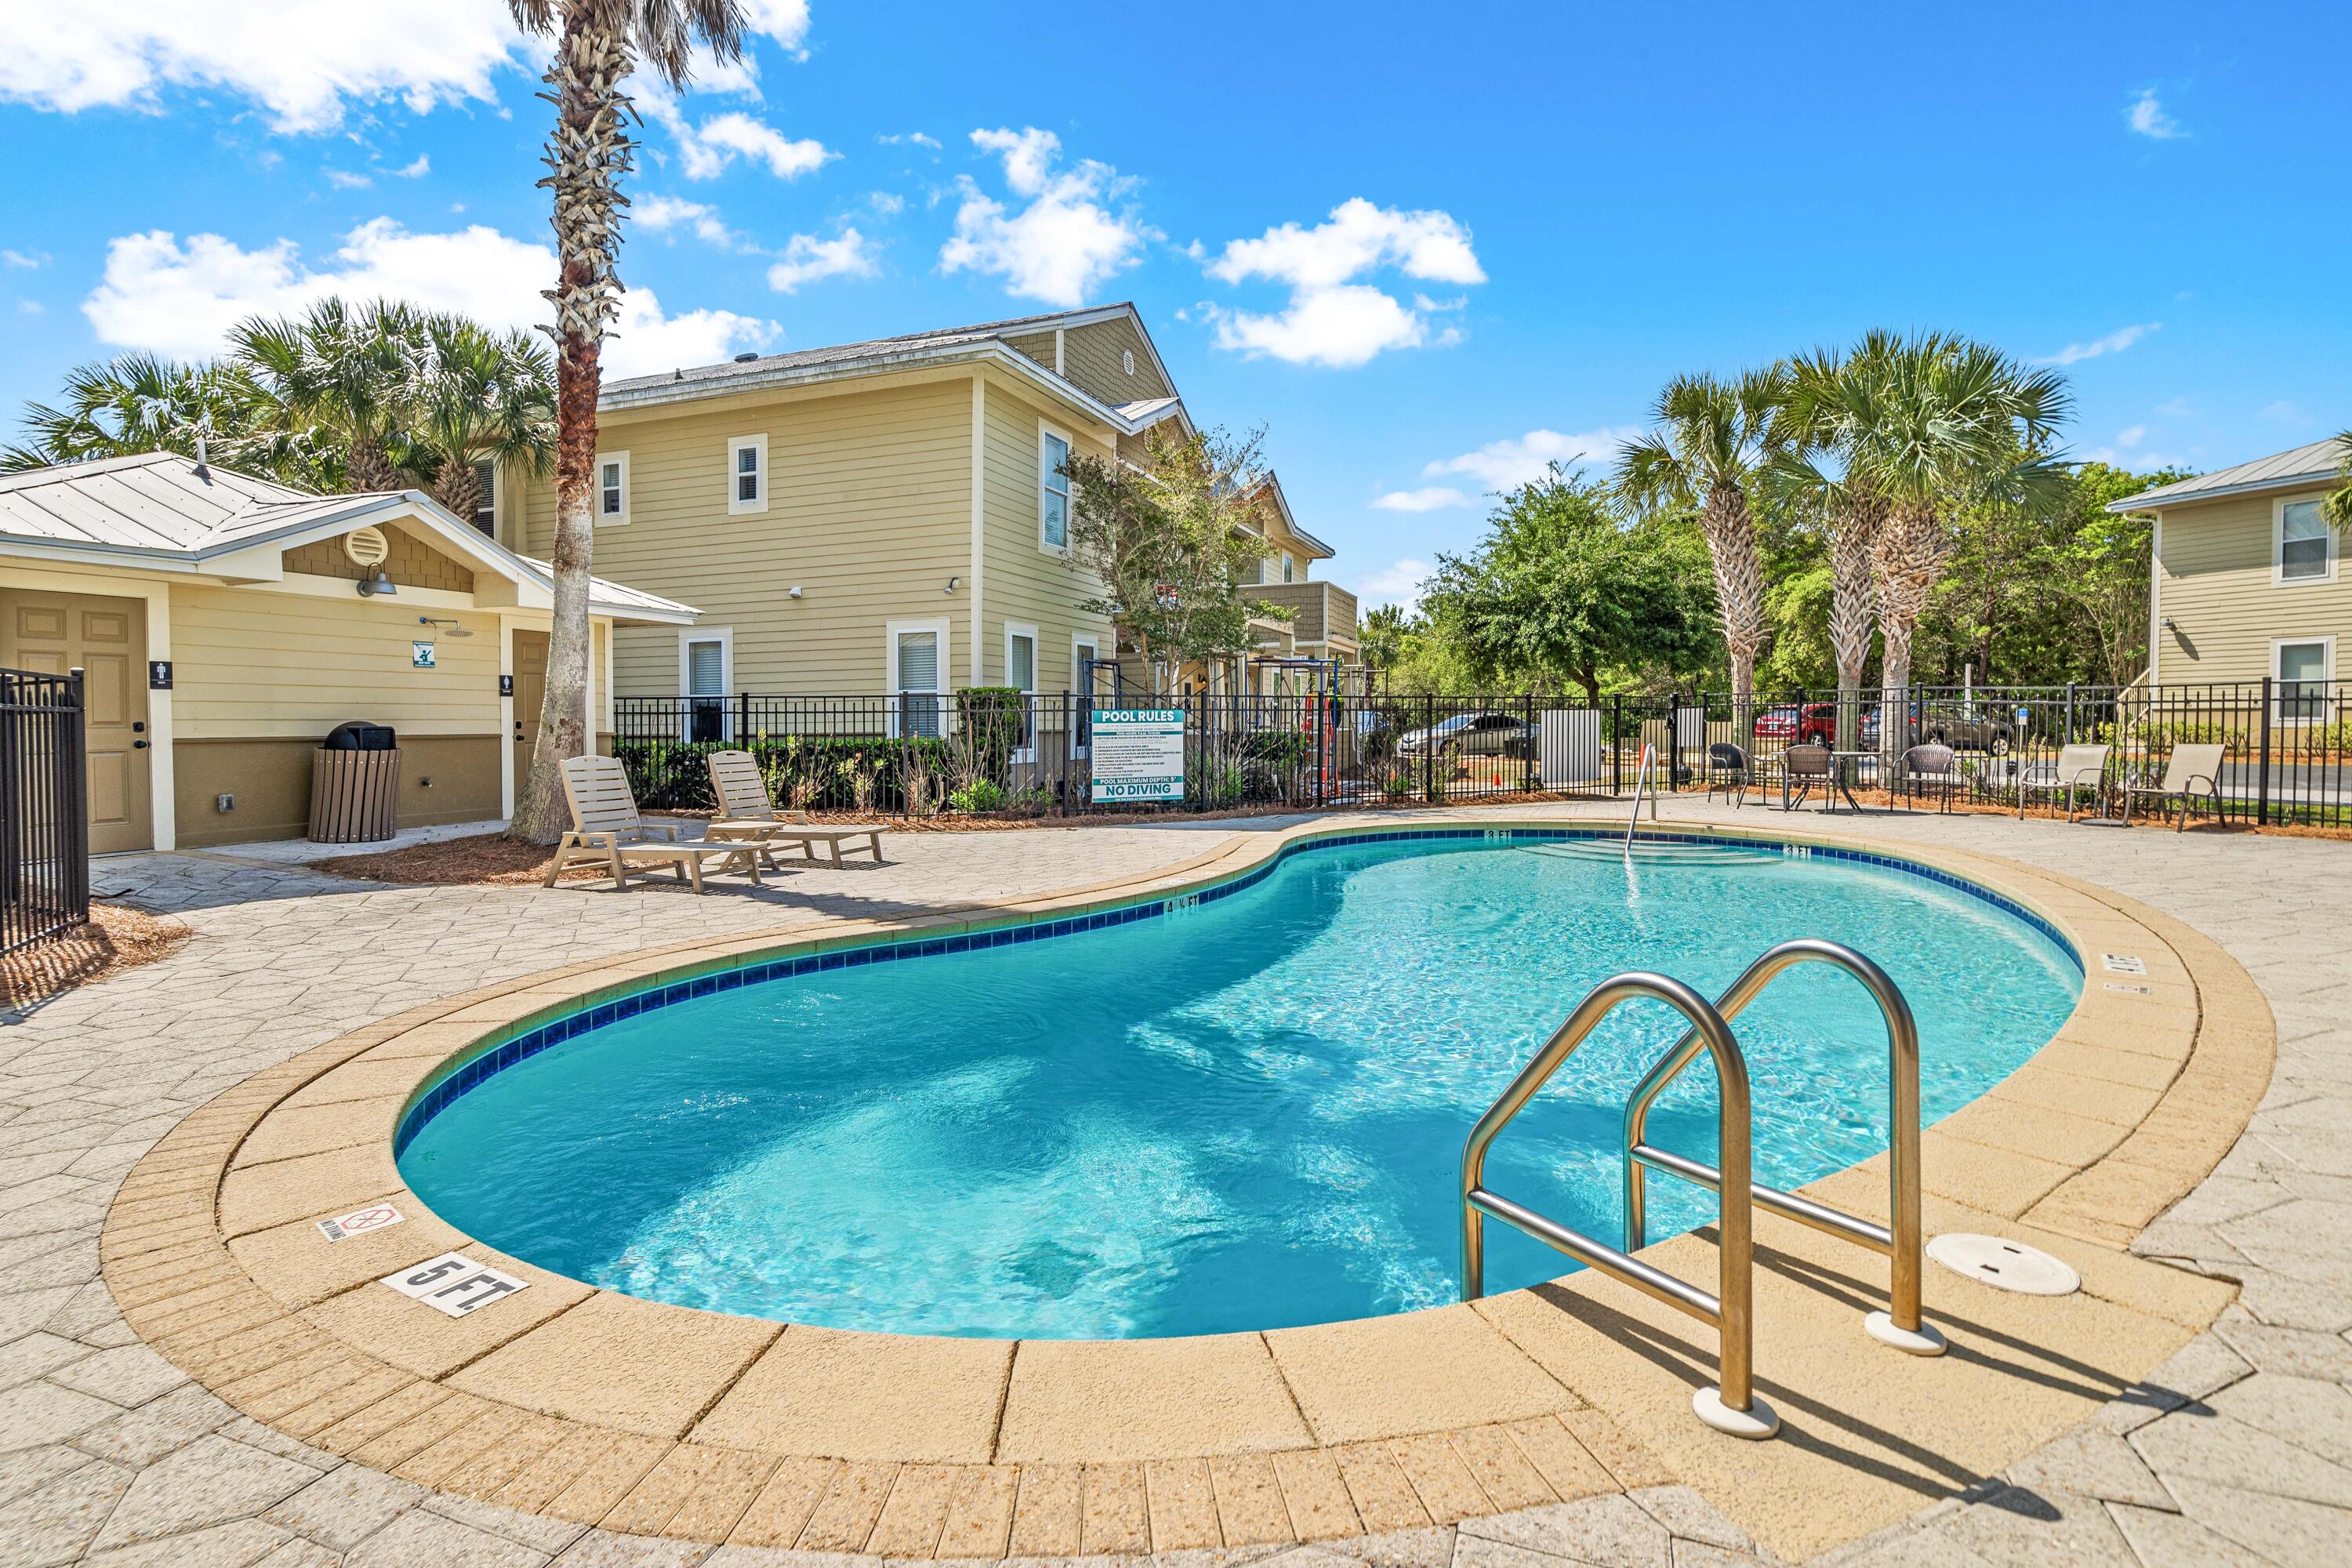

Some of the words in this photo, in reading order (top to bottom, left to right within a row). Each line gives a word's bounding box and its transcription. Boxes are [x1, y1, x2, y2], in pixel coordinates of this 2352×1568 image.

[1102, 711, 1136, 722] POOL
[1138, 711, 1174, 721] RULES
[1106, 786, 1125, 796] NO
[1127, 784, 1171, 795] DIVING
[1499, 830, 1510, 838] FT
[1788, 844, 1793, 853] 3
[1798, 845, 1809, 854] FT
[1167, 901, 1173, 913] 4
[1188, 895, 1198, 907] FT
[325, 1225, 347, 1240] DIVING
[406, 1260, 466, 1286] 5
